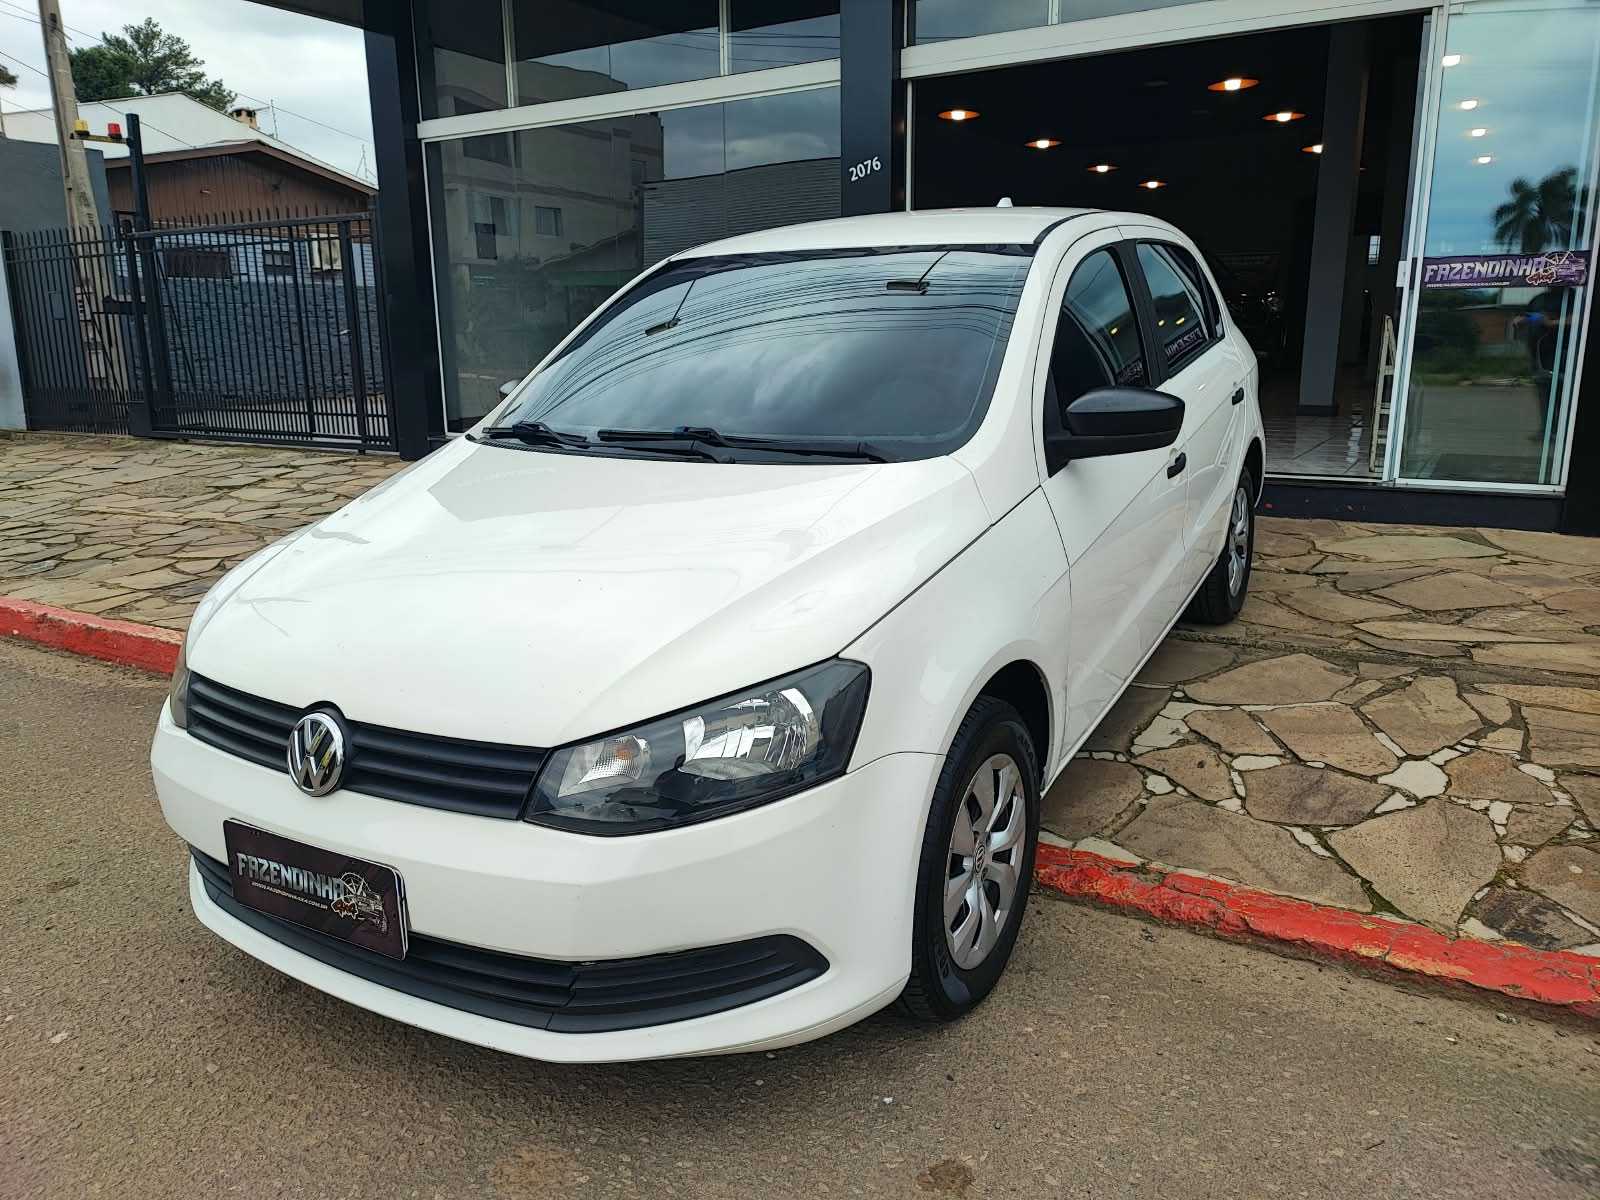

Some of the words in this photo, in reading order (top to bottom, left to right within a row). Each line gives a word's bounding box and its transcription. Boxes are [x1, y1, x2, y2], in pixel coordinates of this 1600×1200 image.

[849, 156, 881, 182] 2076
[1424, 257, 1545, 282] FAZENDINHA
[236, 852, 345, 901] FAZENDINHA
